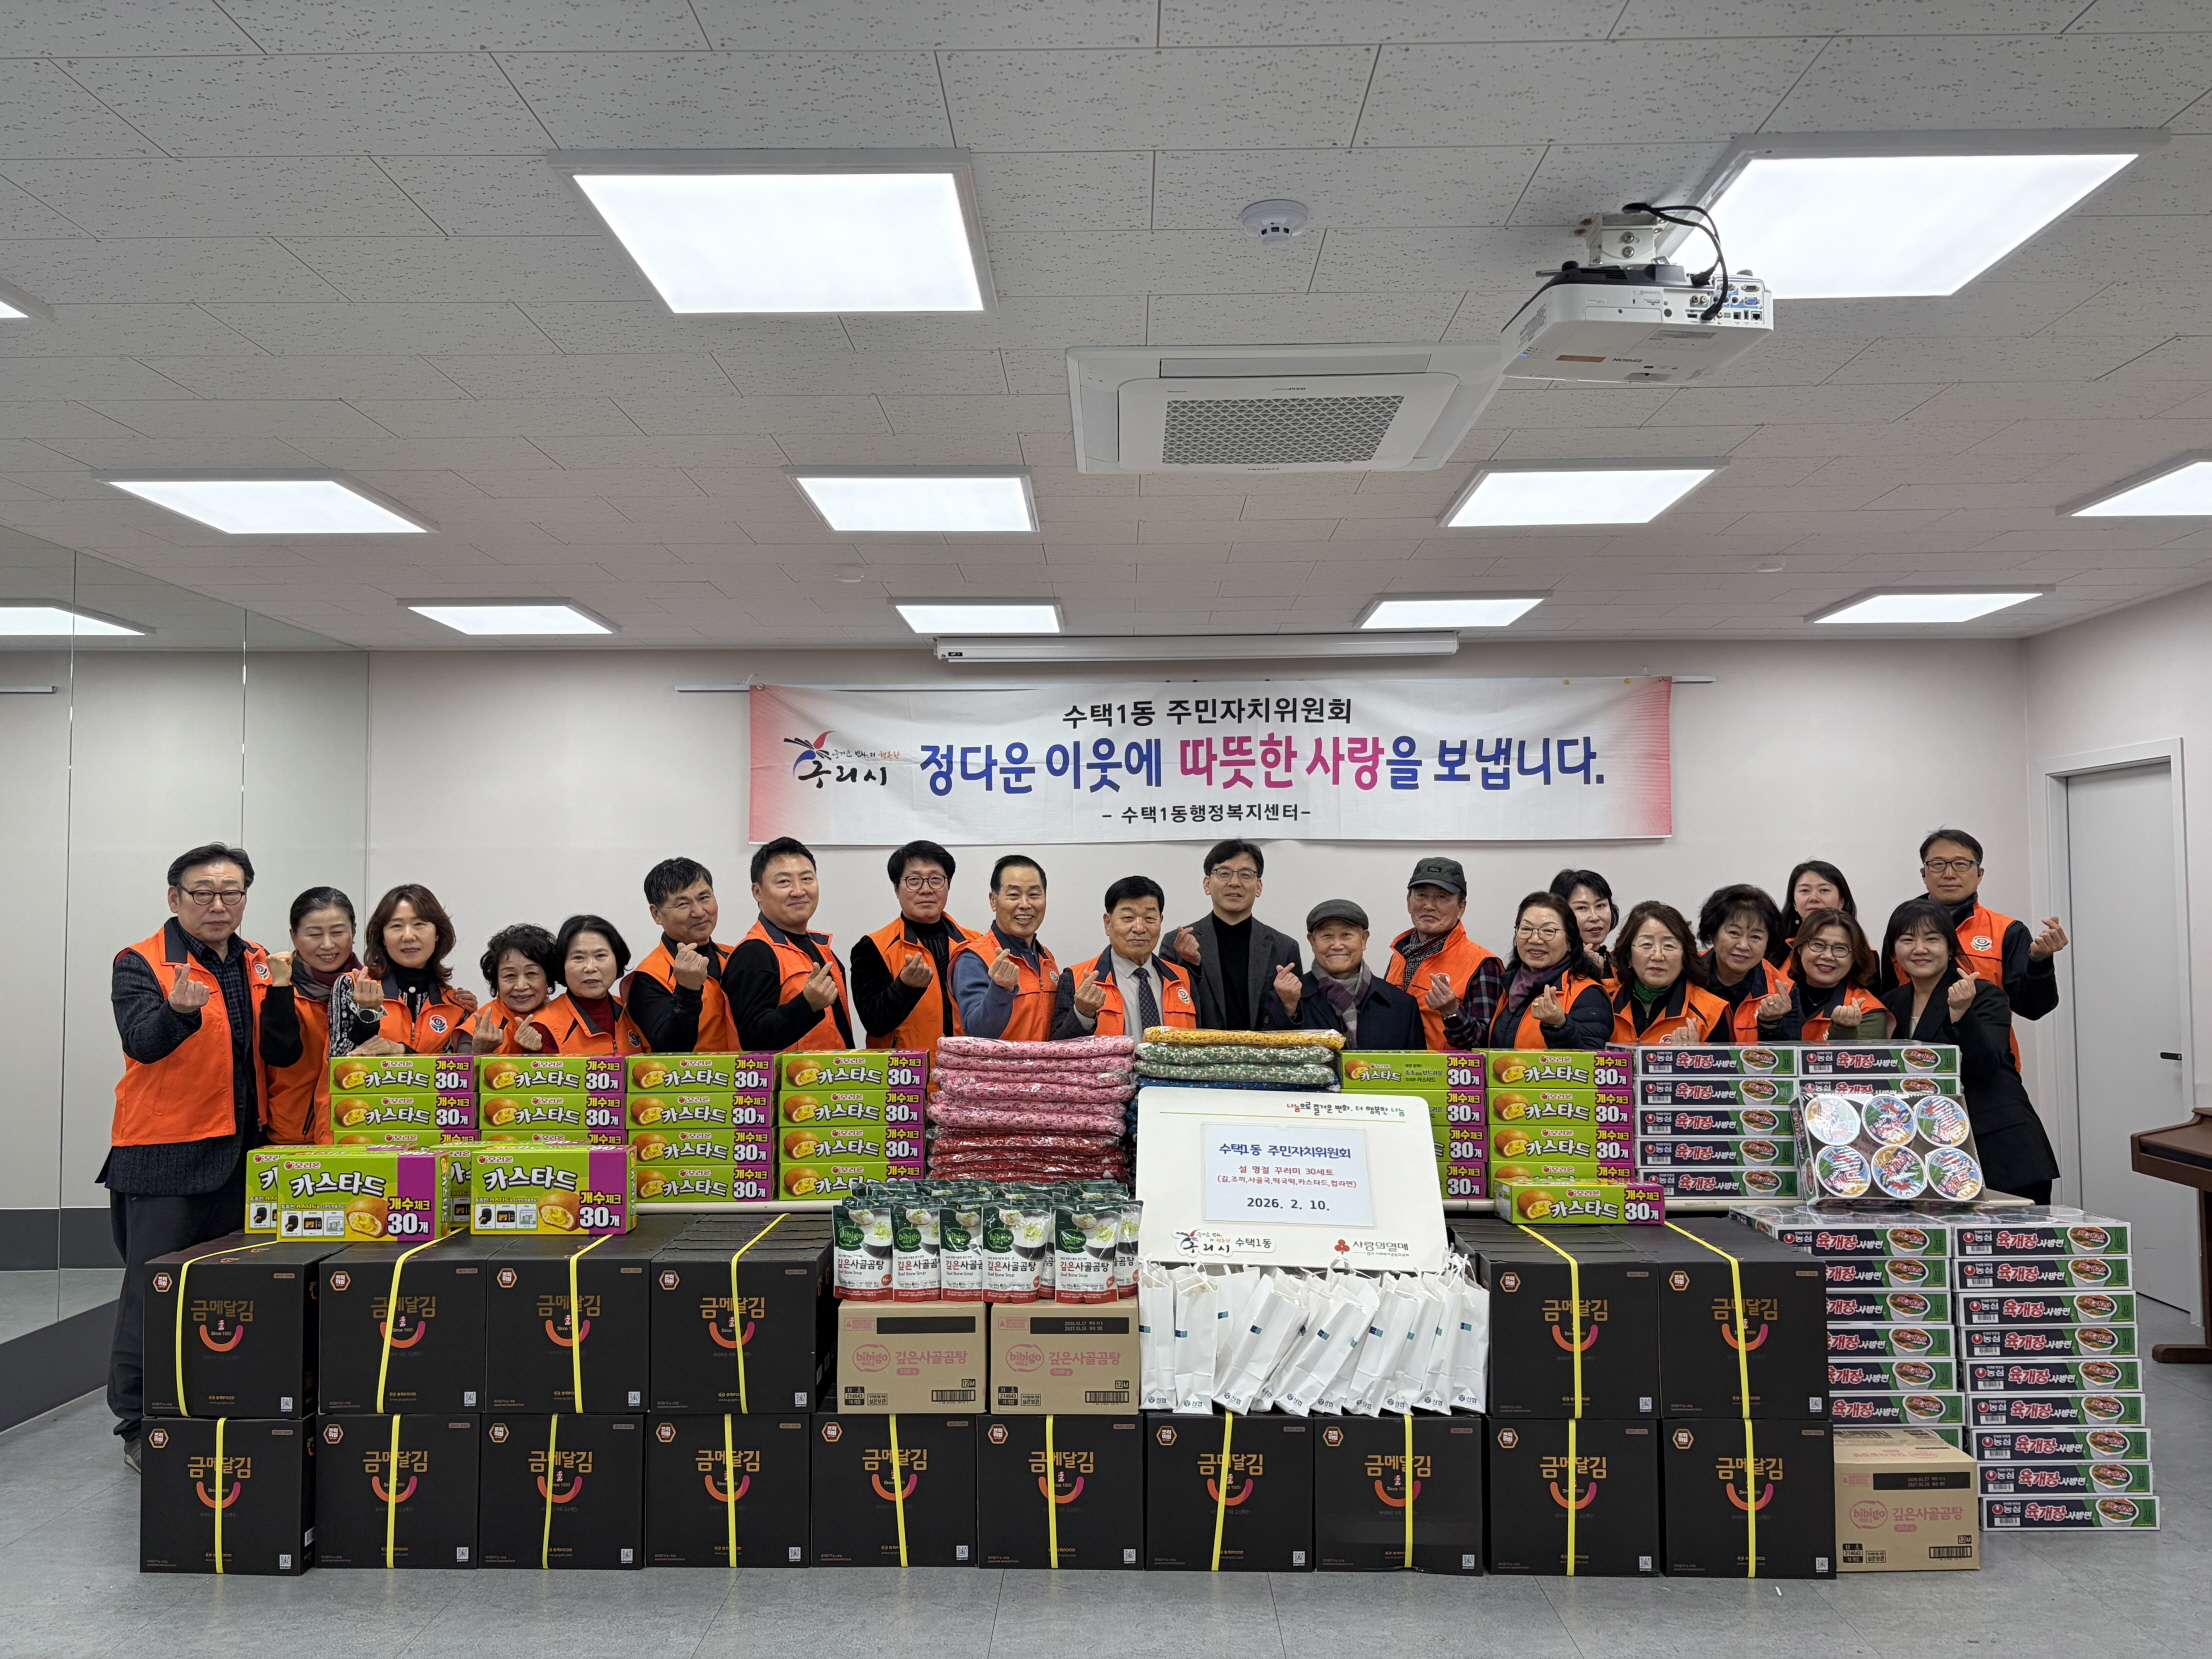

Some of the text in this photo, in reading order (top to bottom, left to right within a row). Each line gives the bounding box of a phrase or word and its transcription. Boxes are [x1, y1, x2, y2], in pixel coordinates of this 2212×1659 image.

[1062, 697, 1352, 729] 수택1동 주민자치위원회
[919, 732, 1605, 797] 정다운 이웃에 따뜻한 사랑을 보냅니다.
[798, 760, 887, 789] 구리시
[435, 1060, 470, 1071] 개수체크
[586, 1060, 620, 1071] 개수체크
[735, 1059, 769, 1070] 개수체크
[888, 1056, 922, 1068] 개수체크
[1447, 1056, 1481, 1067] 개수체크
[1595, 1056, 1628, 1067] 개수체크
[1676, 1052, 1714, 1068] 육개장
[1836, 1052, 1875, 1068] 육개장
[364, 1070, 430, 1088] 카스타드
[435, 1072, 468, 1091] 30개
[514, 1070, 580, 1089] 카스타드
[585, 1072, 619, 1091] 30개
[663, 1069, 729, 1088] 카스타드
[735, 1071, 768, 1090] 30개
[817, 1066, 882, 1085] 카스타드
[887, 1069, 920, 1086] 30개
[1360, 1070, 1402, 1083] 카스타드
[1447, 1068, 1480, 1086] 30개
[1524, 1066, 1589, 1084] 카스타드
[1594, 1068, 1626, 1086] 30개
[885, 1093, 919, 1105] 개수체크
[1447, 1093, 1481, 1104] 개수체크
[1596, 1093, 1629, 1105] 개수체크
[1675, 1083, 1713, 1099] 육개장
[436, 1097, 470, 1108] 개수체크
[586, 1097, 620, 1108] 개수체크
[732, 1095, 766, 1107] 개수체크
[1286, 1101, 1311, 1113] 나눔으로
[1313, 1104, 1333, 1116] 즐거운
[1366, 1105, 1388, 1115] 행복한
[365, 1106, 430, 1125] 카스타드
[435, 1109, 469, 1126] 30개
[514, 1106, 580, 1125] 카스타드
[585, 1109, 619, 1127] 30개
[661, 1106, 728, 1124] 카스타드
[732, 1107, 765, 1126] 30개
[814, 1103, 880, 1121] 카스타드
[885, 1105, 918, 1122] 30개
[1447, 1105, 1480, 1123] 30개
[1524, 1103, 1590, 1121] 카스타드
[1595, 1105, 1628, 1123] 30개
[734, 1131, 768, 1143] 개수체크
[886, 1129, 919, 1140] 개수체크
[1450, 1130, 1483, 1141] 개수체크
[1597, 1130, 1630, 1141] 개수체크
[663, 1142, 729, 1160] 카스타드
[734, 1144, 767, 1162] 30개
[814, 1139, 880, 1157] 카스타드
[885, 1140, 918, 1158] 30개
[1219, 1143, 1351, 1159] 수택1동 주민자치위원회
[1450, 1141, 1482, 1159] 30개
[1525, 1140, 1590, 1158] 카스타드
[1596, 1142, 1629, 1160] 30개
[483, 1166, 578, 1192] 카스타드
[734, 1169, 767, 1180] 개수체크
[886, 1165, 920, 1177] 개수체크
[1239, 1165, 1334, 1176] 설 명절 꾸러미 30세트
[1447, 1166, 1481, 1177] 개수체크
[1597, 1166, 1631, 1177] 개수체크
[290, 1172, 386, 1197] 카스타드
[662, 1179, 728, 1197] 카스타드
[733, 1181, 766, 1199] 30개
[1447, 1178, 1480, 1196] 30개
[388, 1197, 431, 1211] 개수체크
[580, 1191, 622, 1205] 개수체크
[1247, 1197, 1330, 1211] 2026. 2. 10.
[1625, 1190, 1659, 1201] 개수체크
[579, 1206, 620, 1229] 30개
[1550, 1199, 1618, 1219] 카스타드
[1625, 1202, 1659, 1221] 30개
[387, 1212, 430, 1236] 30개
[1235, 1237, 1272, 1249] 수택1동
[1352, 1240, 1409, 1252] 사랑의열매
[1816, 1229, 1857, 1249] 육개장
[1996, 1229, 2036, 1249] 육개장
[987, 1261, 1036, 1272] 깊은사골곰탕
[1060, 1261, 1110, 1272] 깊은사골곰탕
[191, 1300, 254, 1322] 금메달김
[2003, 1298, 2044, 1318] 육개장
[856, 1352, 888, 1365] bibigo
[895, 1350, 968, 1365] 깊은사골곰탕
[1009, 1352, 1041, 1365] bibigo
[1048, 1351, 1122, 1366] 깊은사골곰탕
[2008, 1365, 2049, 1385] 육개장
[2015, 1435, 2057, 1455] 육개장
[1853, 1507, 1886, 1521] bibigo
[1892, 1506, 1964, 1521] 깊은사골곰탕
[2025, 1502, 2066, 1522] 육개장
